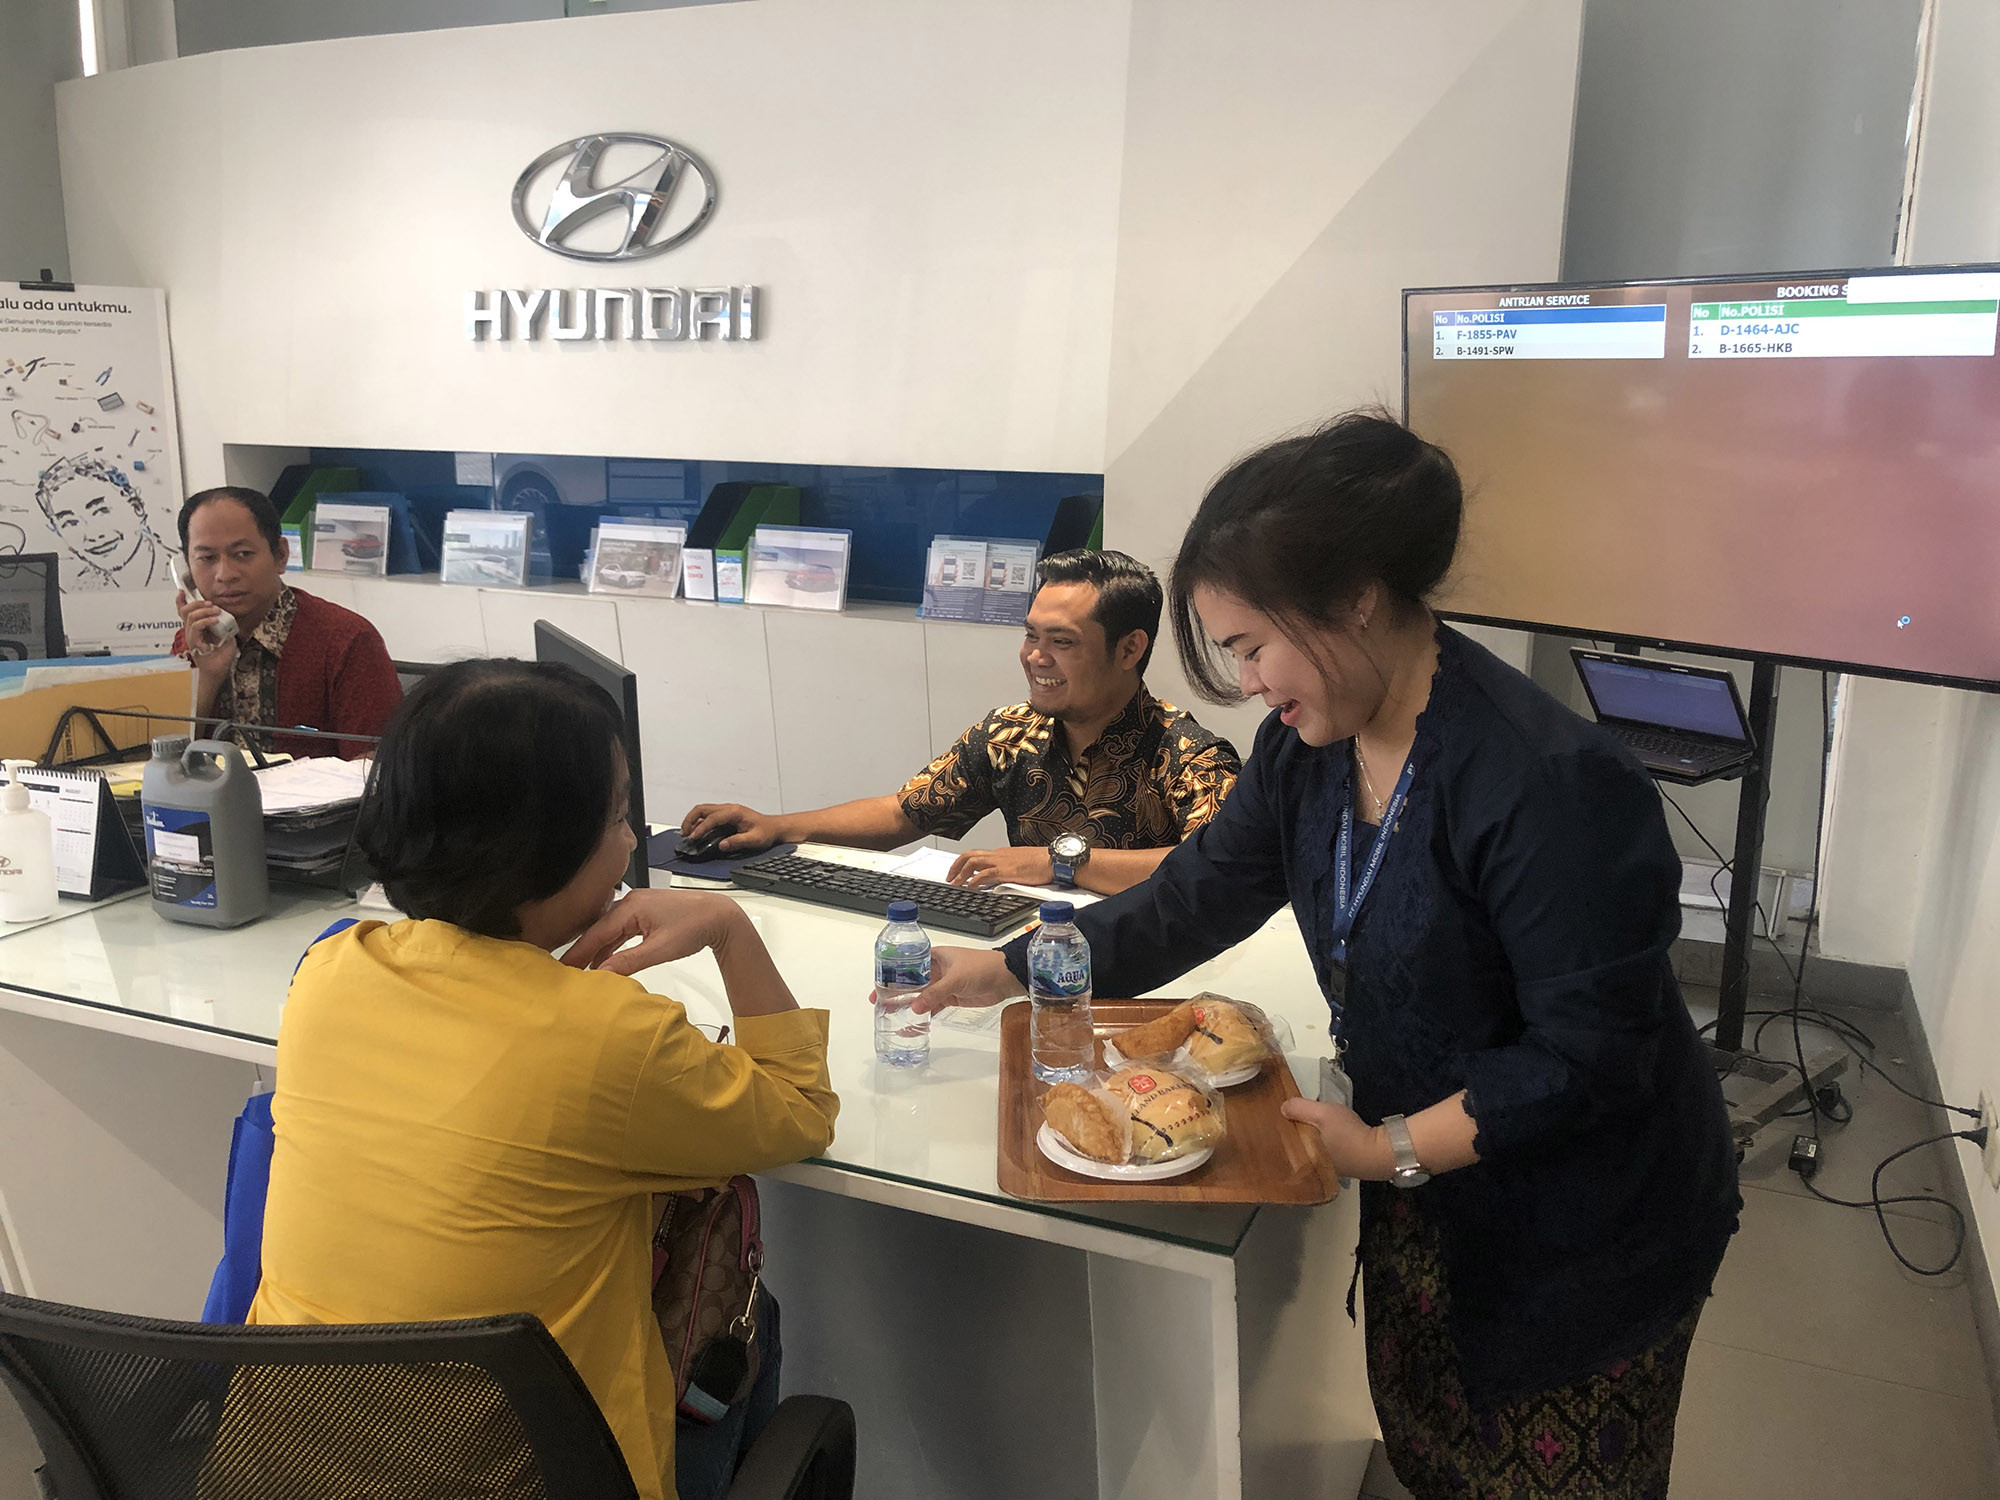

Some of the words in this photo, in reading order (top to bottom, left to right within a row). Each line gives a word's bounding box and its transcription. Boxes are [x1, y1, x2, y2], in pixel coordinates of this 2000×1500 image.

[1777, 284, 1839, 298] BOOKING
[23, 299, 54, 311] ada
[58, 301, 132, 314] untukmu.
[1499, 296, 1544, 307] ANTRIAN
[1546, 294, 1590, 306] SERVICE
[464, 285, 759, 341] HYUNDAI
[1693, 307, 1710, 318] No
[1721, 304, 1785, 318] No.POLISI
[1435, 315, 1448, 324] No
[1457, 313, 1505, 324] No.POLISI
[1436, 331, 1445, 340] 1.
[1457, 329, 1518, 340] F-1855-PAV
[1693, 326, 1704, 336] 1.
[1720, 323, 1800, 336] D-1464-AJC
[1435, 346, 1444, 355] 2.
[1456, 346, 1515, 355] B-1491-SPW
[1691, 344, 1702, 354] 2.
[1719, 343, 1793, 354] B-1665-HKB
[1407, 762, 1415, 775] PT
[1340, 830, 1348, 859] MOBIL
[1348, 906, 1356, 918] PT
[1353, 868, 1373, 907] HYUNDAI
[1370, 841, 1385, 869] MOBIL
[1380, 793, 1402, 840] INDONESIA
[1339, 861, 1347, 909] INDONESIA
[1056, 969, 1085, 984] AQUA
